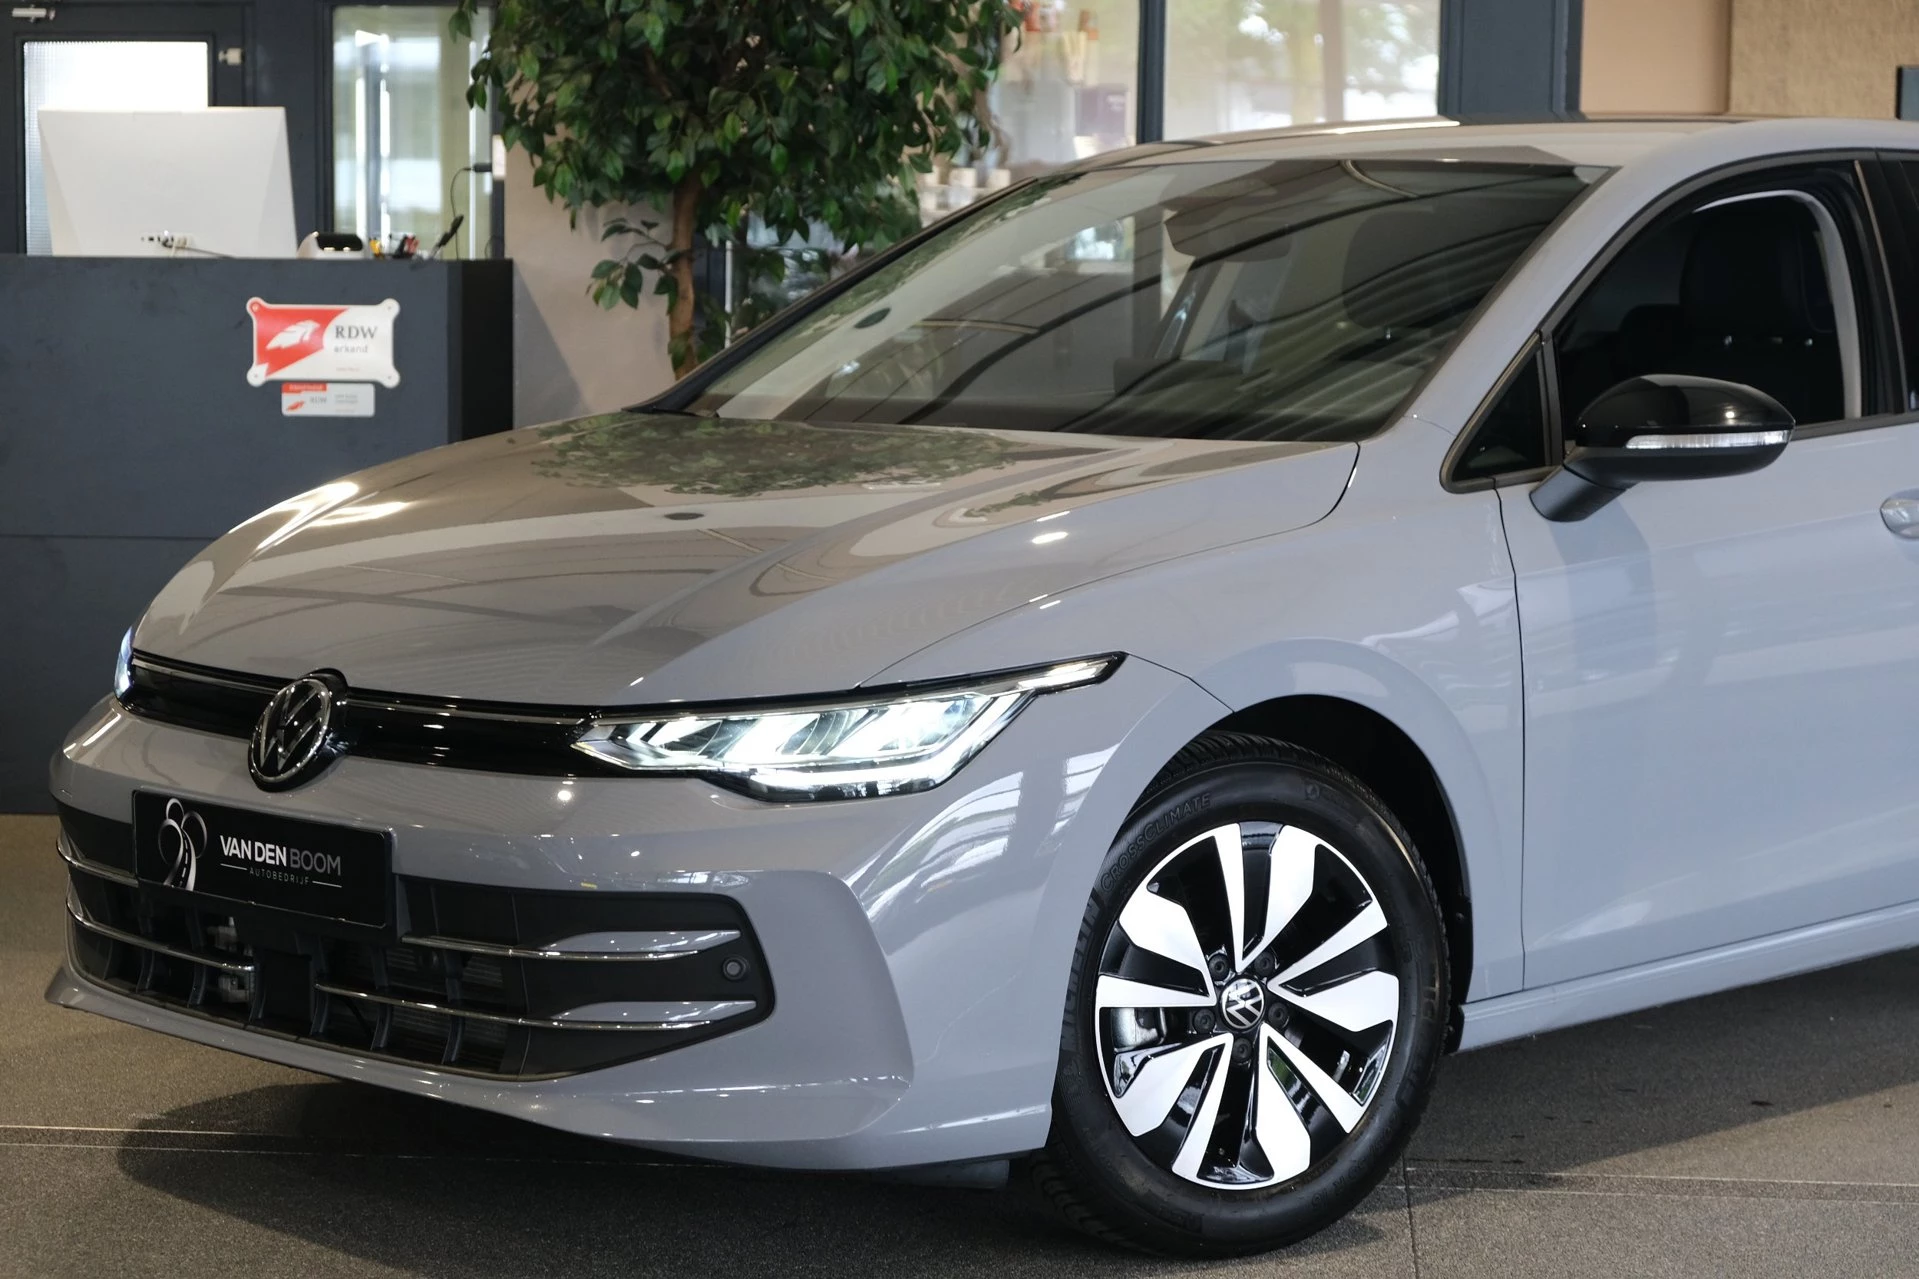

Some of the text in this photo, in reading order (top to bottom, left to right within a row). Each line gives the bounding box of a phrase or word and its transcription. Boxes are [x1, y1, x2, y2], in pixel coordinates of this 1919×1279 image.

[335, 326, 377, 338] RDW
[219, 834, 342, 877] VAN DEN BOOM
[1101, 793, 1212, 893] CROSSCLIMATE
[249, 869, 311, 884] AUTOBEDRIJF
